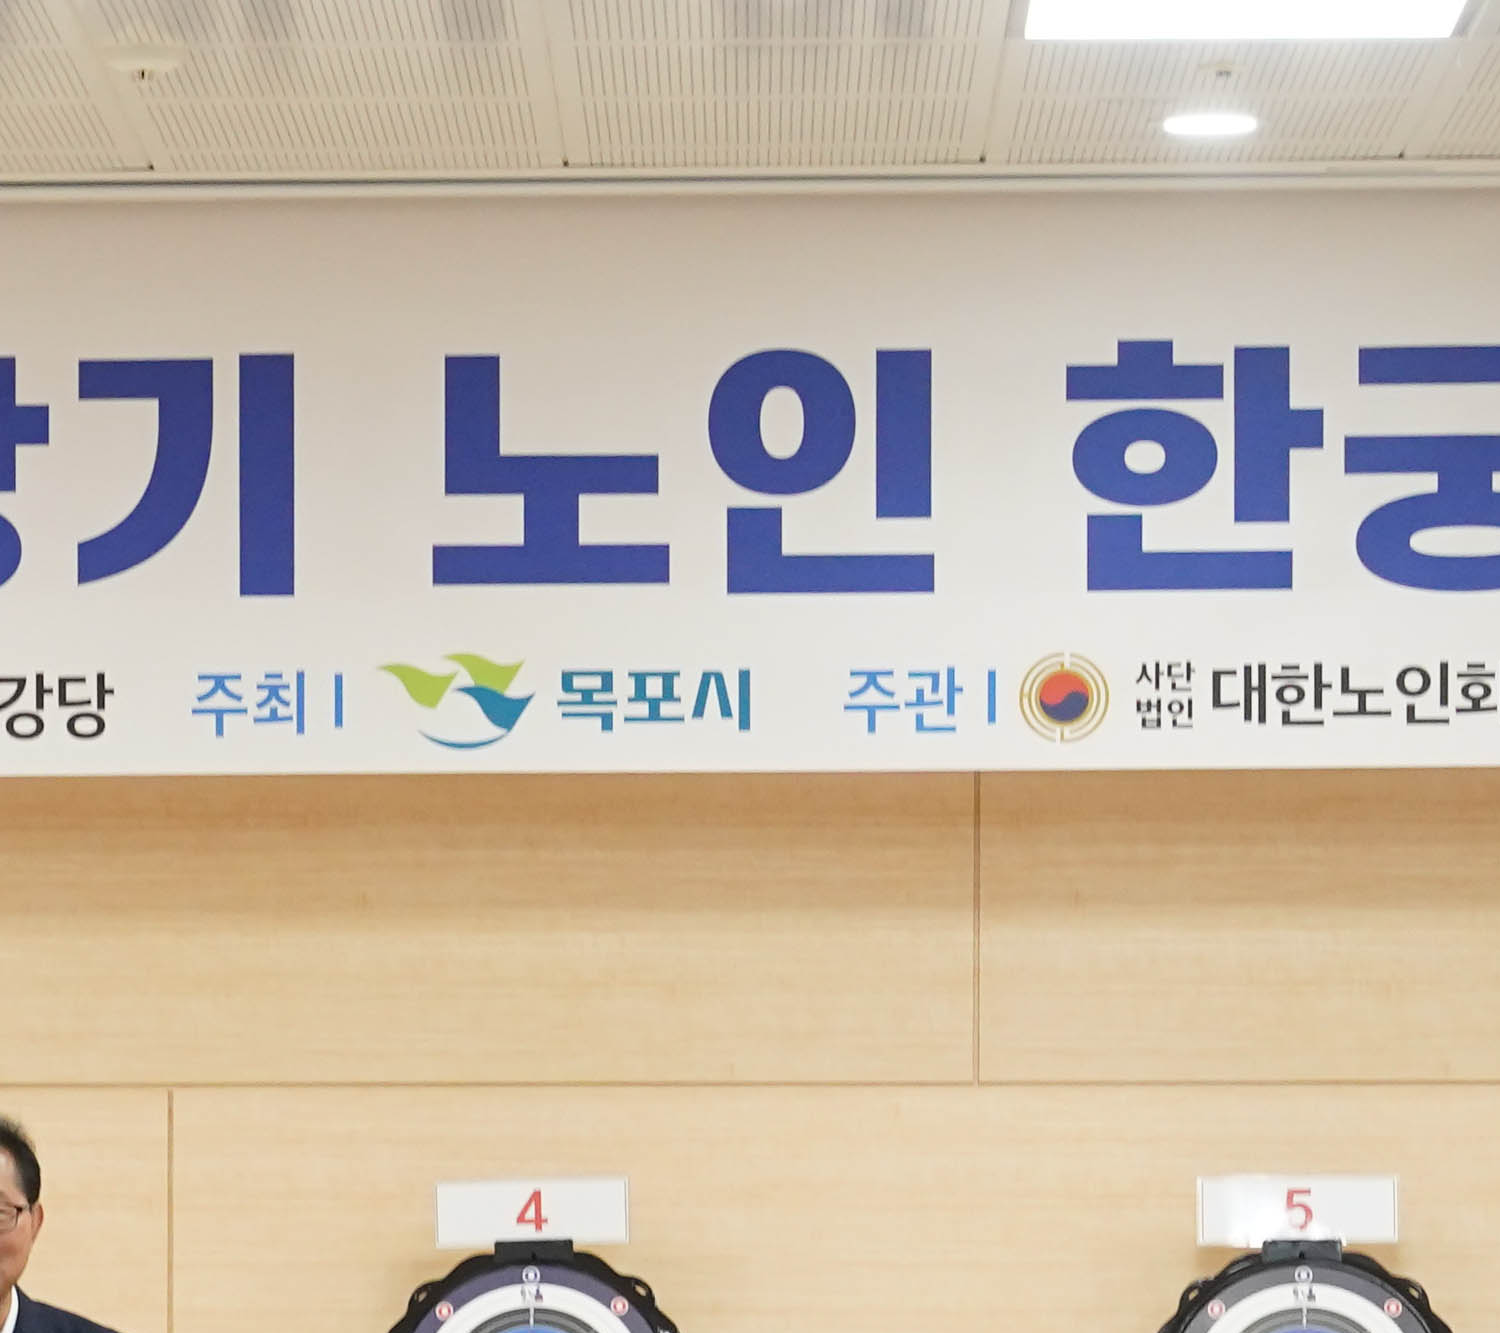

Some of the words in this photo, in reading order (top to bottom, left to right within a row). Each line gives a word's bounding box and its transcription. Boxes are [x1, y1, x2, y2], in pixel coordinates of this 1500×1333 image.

[431, 347, 935, 595] 노인
[1135, 661, 1196, 692] 사단
[191, 670, 305, 737] 주최
[556, 668, 751, 733] 목포시
[843, 666, 964, 734] 주관
[1135, 697, 1193, 729] 법인
[516, 1189, 548, 1232] 4
[1286, 1188, 1313, 1230] 5
